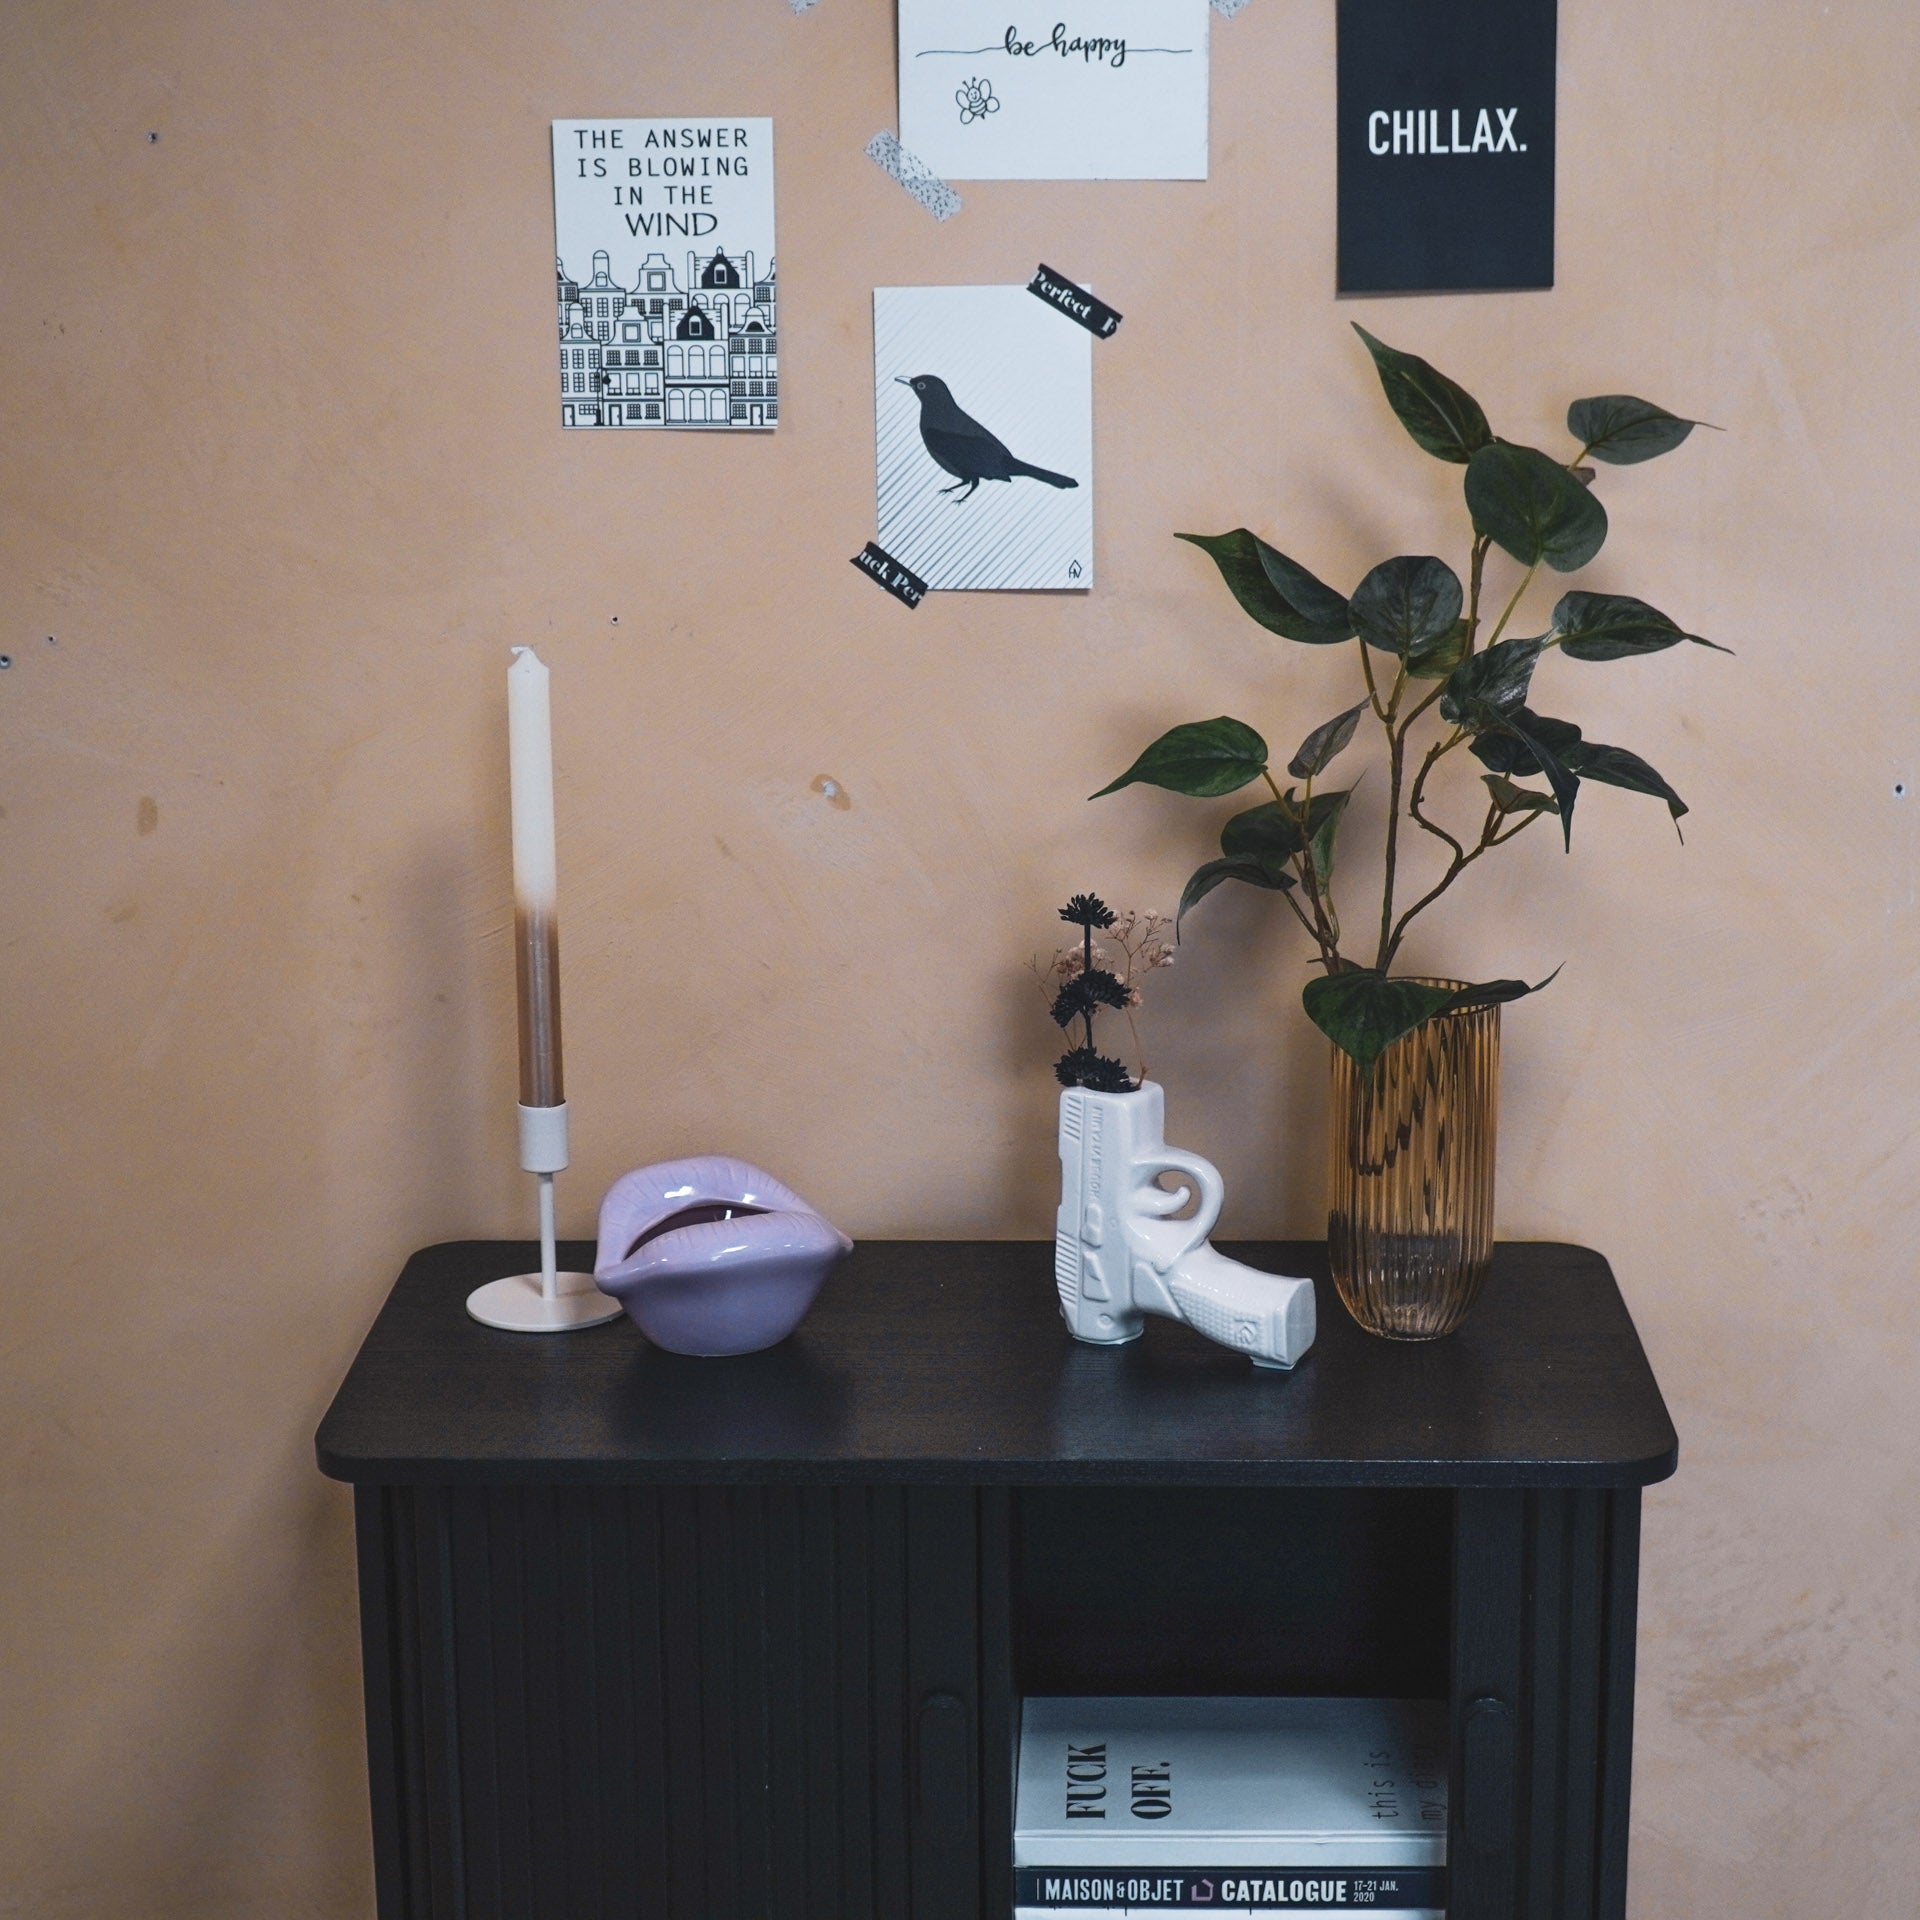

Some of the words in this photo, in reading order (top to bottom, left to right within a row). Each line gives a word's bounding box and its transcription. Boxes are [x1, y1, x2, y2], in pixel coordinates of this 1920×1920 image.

[1004, 25, 1036, 56] be
[1052, 22, 1126, 68] happy
[574, 129, 624, 149] THE
[645, 128, 749, 148] ANSWER
[1368, 107, 1528, 155] CHILLAX.
[577, 157, 607, 177] IS
[628, 157, 749, 176] BLOWING
[613, 186, 643, 206] IN
[664, 185, 713, 205] THE
[625, 212, 718, 236] WIND
[1363, 1752, 1391, 1768] is
[1066, 1743, 1107, 1819] FUCK
[1131, 1761, 1172, 1819] OFF.
[1367, 1780, 1399, 1819] this
[1419, 1799, 1447, 1821] my
[1221, 1879, 1347, 1902] CATALOGUE
[1353, 1880, 1377, 1892] 17-21
[1379, 1880, 1399, 1892] JAN.
[1353, 1892, 1375, 1902] 2020
